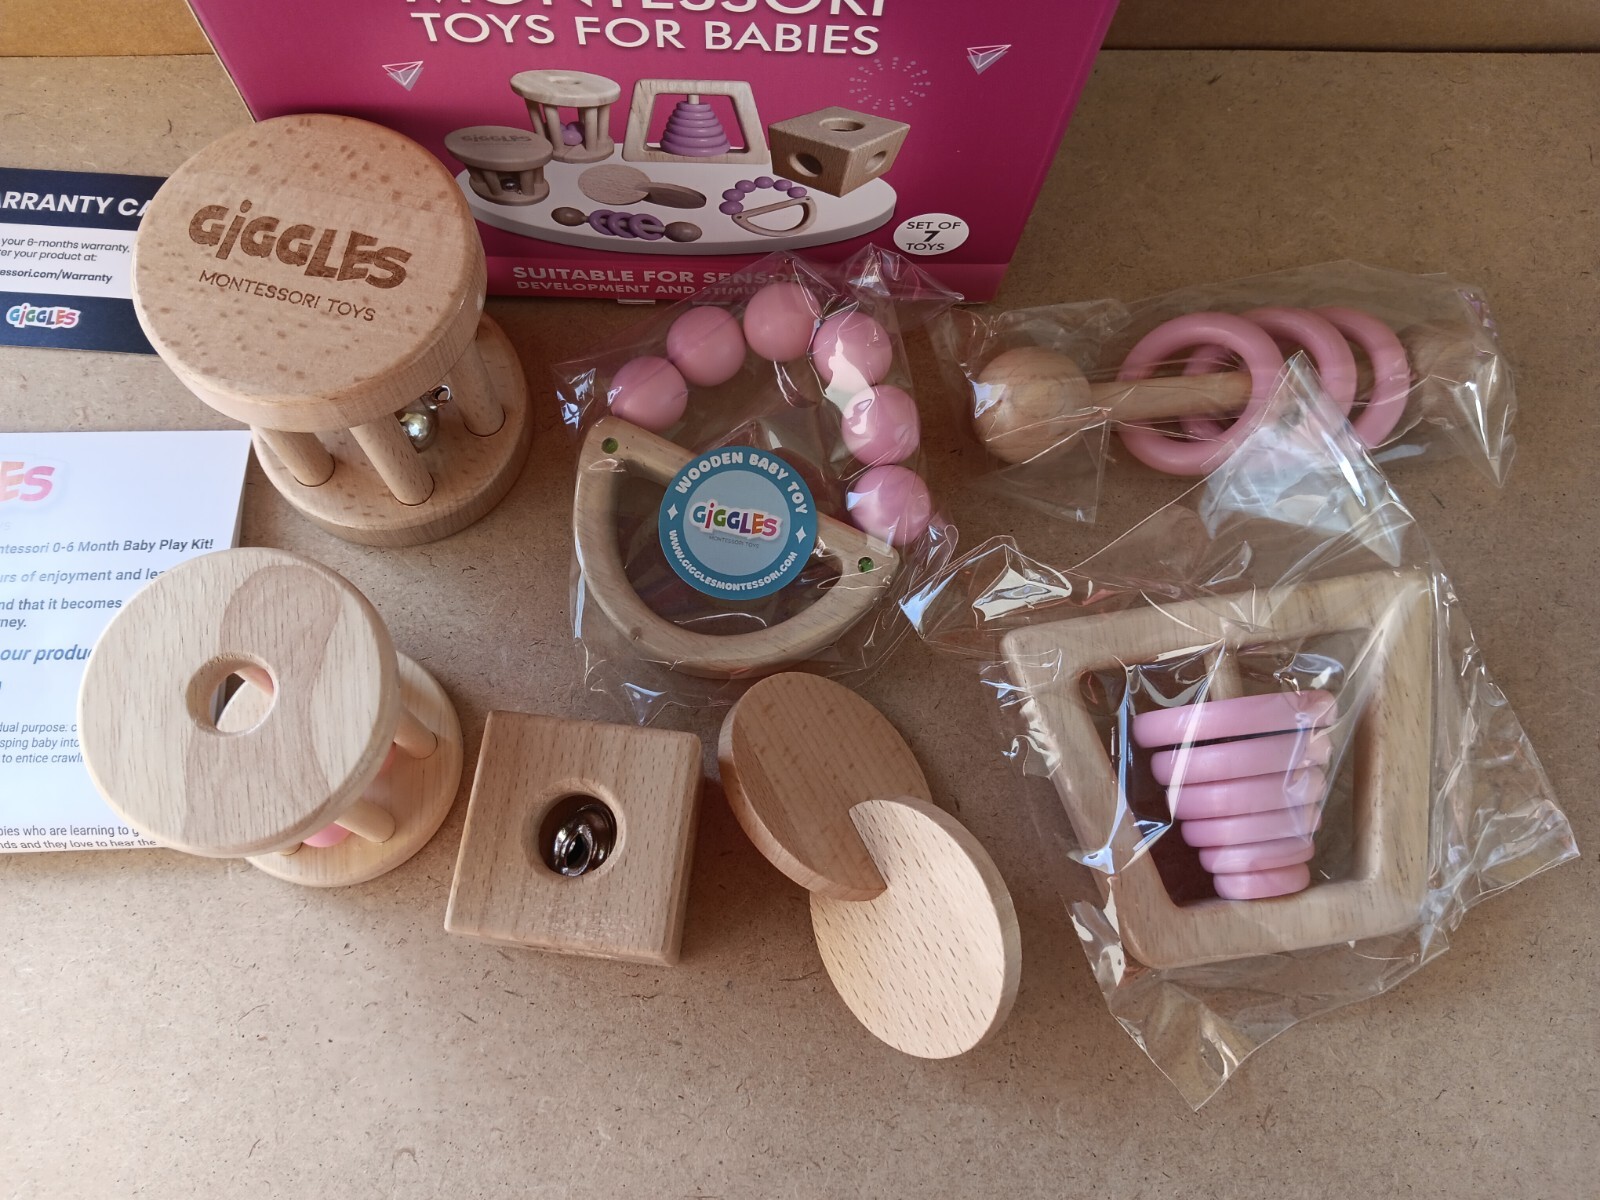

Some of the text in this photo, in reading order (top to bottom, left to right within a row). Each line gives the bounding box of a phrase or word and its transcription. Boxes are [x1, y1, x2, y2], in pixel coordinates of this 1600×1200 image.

[410, 12, 880, 55] TOYS FOR BABIES
[0, 191, 114, 214] RRANTY
[906, 221, 961, 229] SET OF
[923, 230, 940, 242] 7
[1, 238, 130, 254] your 6-months warranty.
[906, 243, 945, 251] TOYS
[14, 250, 38, 260] your
[39, 251, 81, 261] product
[84, 253, 98, 262] at:
[513, 266, 635, 282] SUITABLE
[643, 269, 695, 283] FOR
[516, 280, 650, 294] DEVELOPMENT
[655, 284, 696, 294] AND
[199, 269, 376, 322] MONTESSORI TOYS
[675, 451, 808, 514] WOODEN BABY TOY
[53, 541, 74, 553] 0-6
[78, 540, 119, 552] Month
[123, 540, 156, 553] Baby
[159, 539, 188, 552] Play
[191, 538, 214, 550] Kit!
[668, 529, 798, 591] WWW.GIGGLESMONTESSORI.COM
[21, 570, 37, 582] of
[39, 570, 111, 584] enjoyment
[115, 568, 142, 580] and
[145, 568, 165, 580] le
[18, 598, 45, 610] that
[48, 598, 59, 610] it
[61, 598, 122, 609] becomes
[21, 724, 68, 734] purpose:
[31, 737, 58, 750] baby
[2, 754, 13, 763] to
[15, 753, 48, 763] entice
[23, 825, 46, 836] who
[50, 826, 67, 836] are
[70, 825, 115, 837] learning
[118, 826, 129, 836] to
[20, 840, 42, 849] and
[43, 840, 67, 850] they
[70, 840, 93, 848] love
[95, 840, 108, 848] to
[109, 839, 135, 848] hear
[137, 838, 157, 847] the
